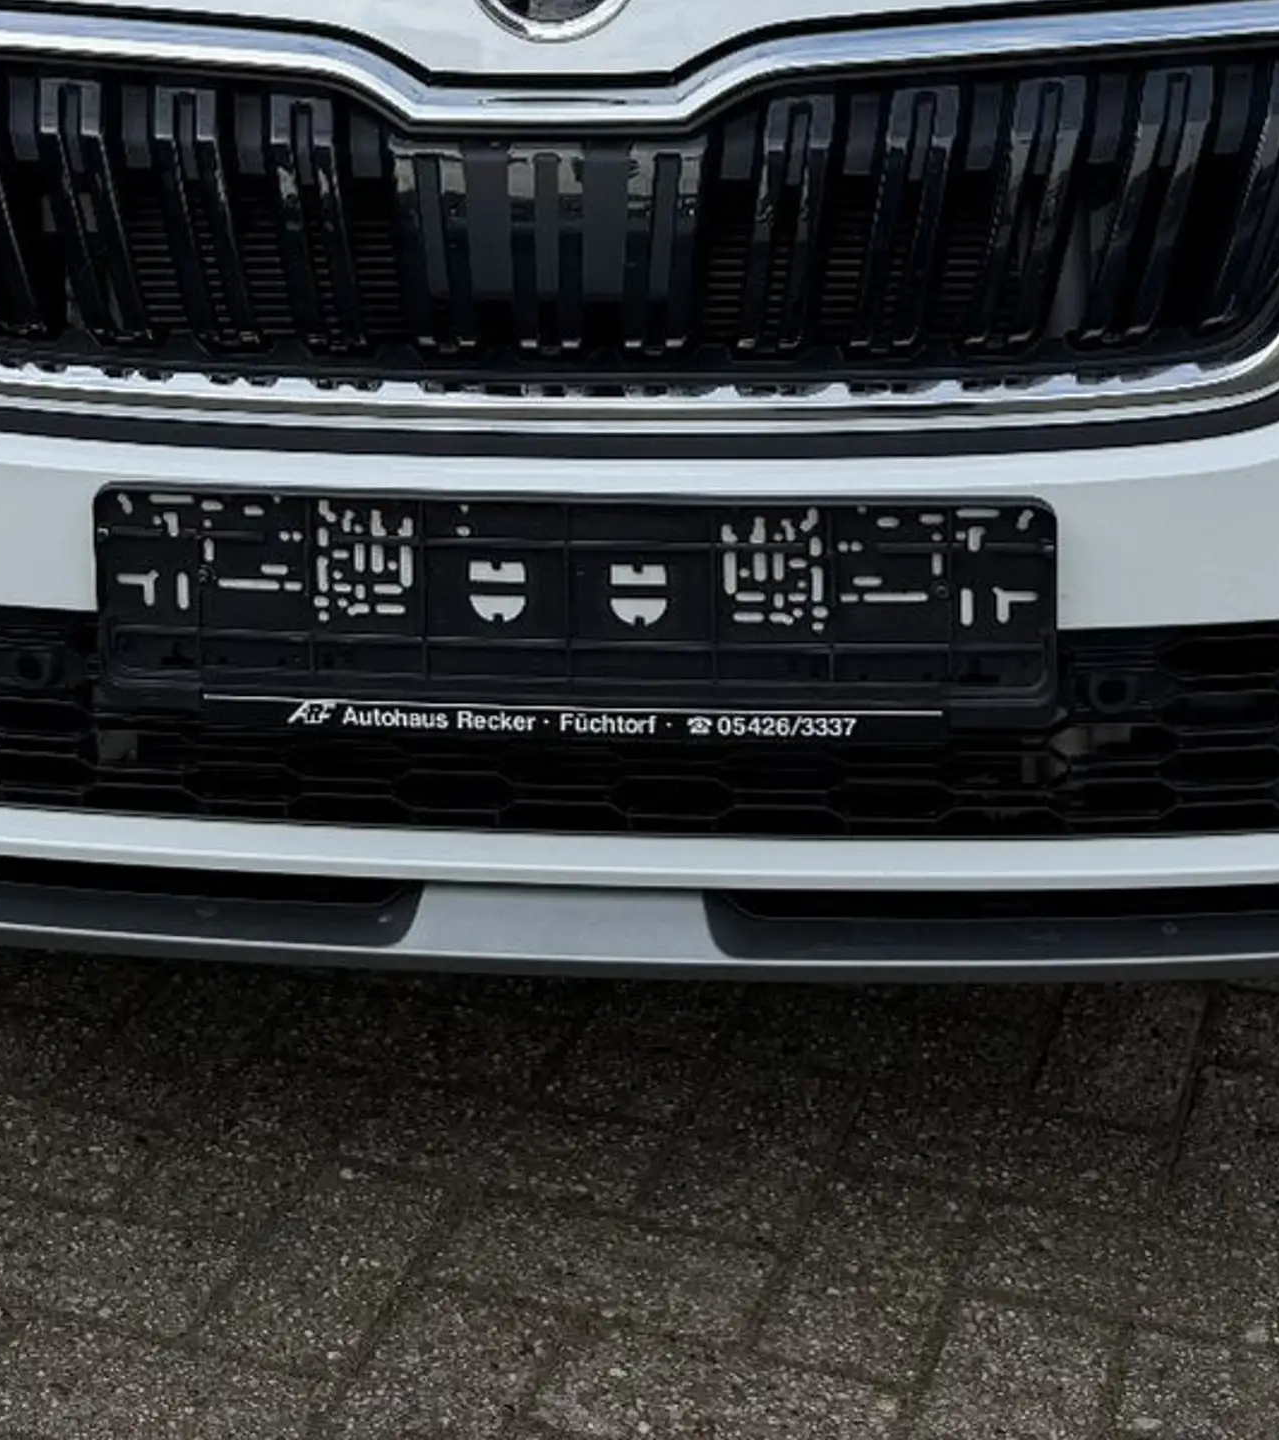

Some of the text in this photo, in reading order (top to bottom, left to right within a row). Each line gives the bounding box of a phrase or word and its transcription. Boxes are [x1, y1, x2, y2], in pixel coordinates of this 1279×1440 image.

[342, 706, 449, 729] Autohaus
[457, 709, 537, 732] Recker
[559, 711, 658, 735] Füchtorf
[717, 715, 857, 737] 05426/3337
